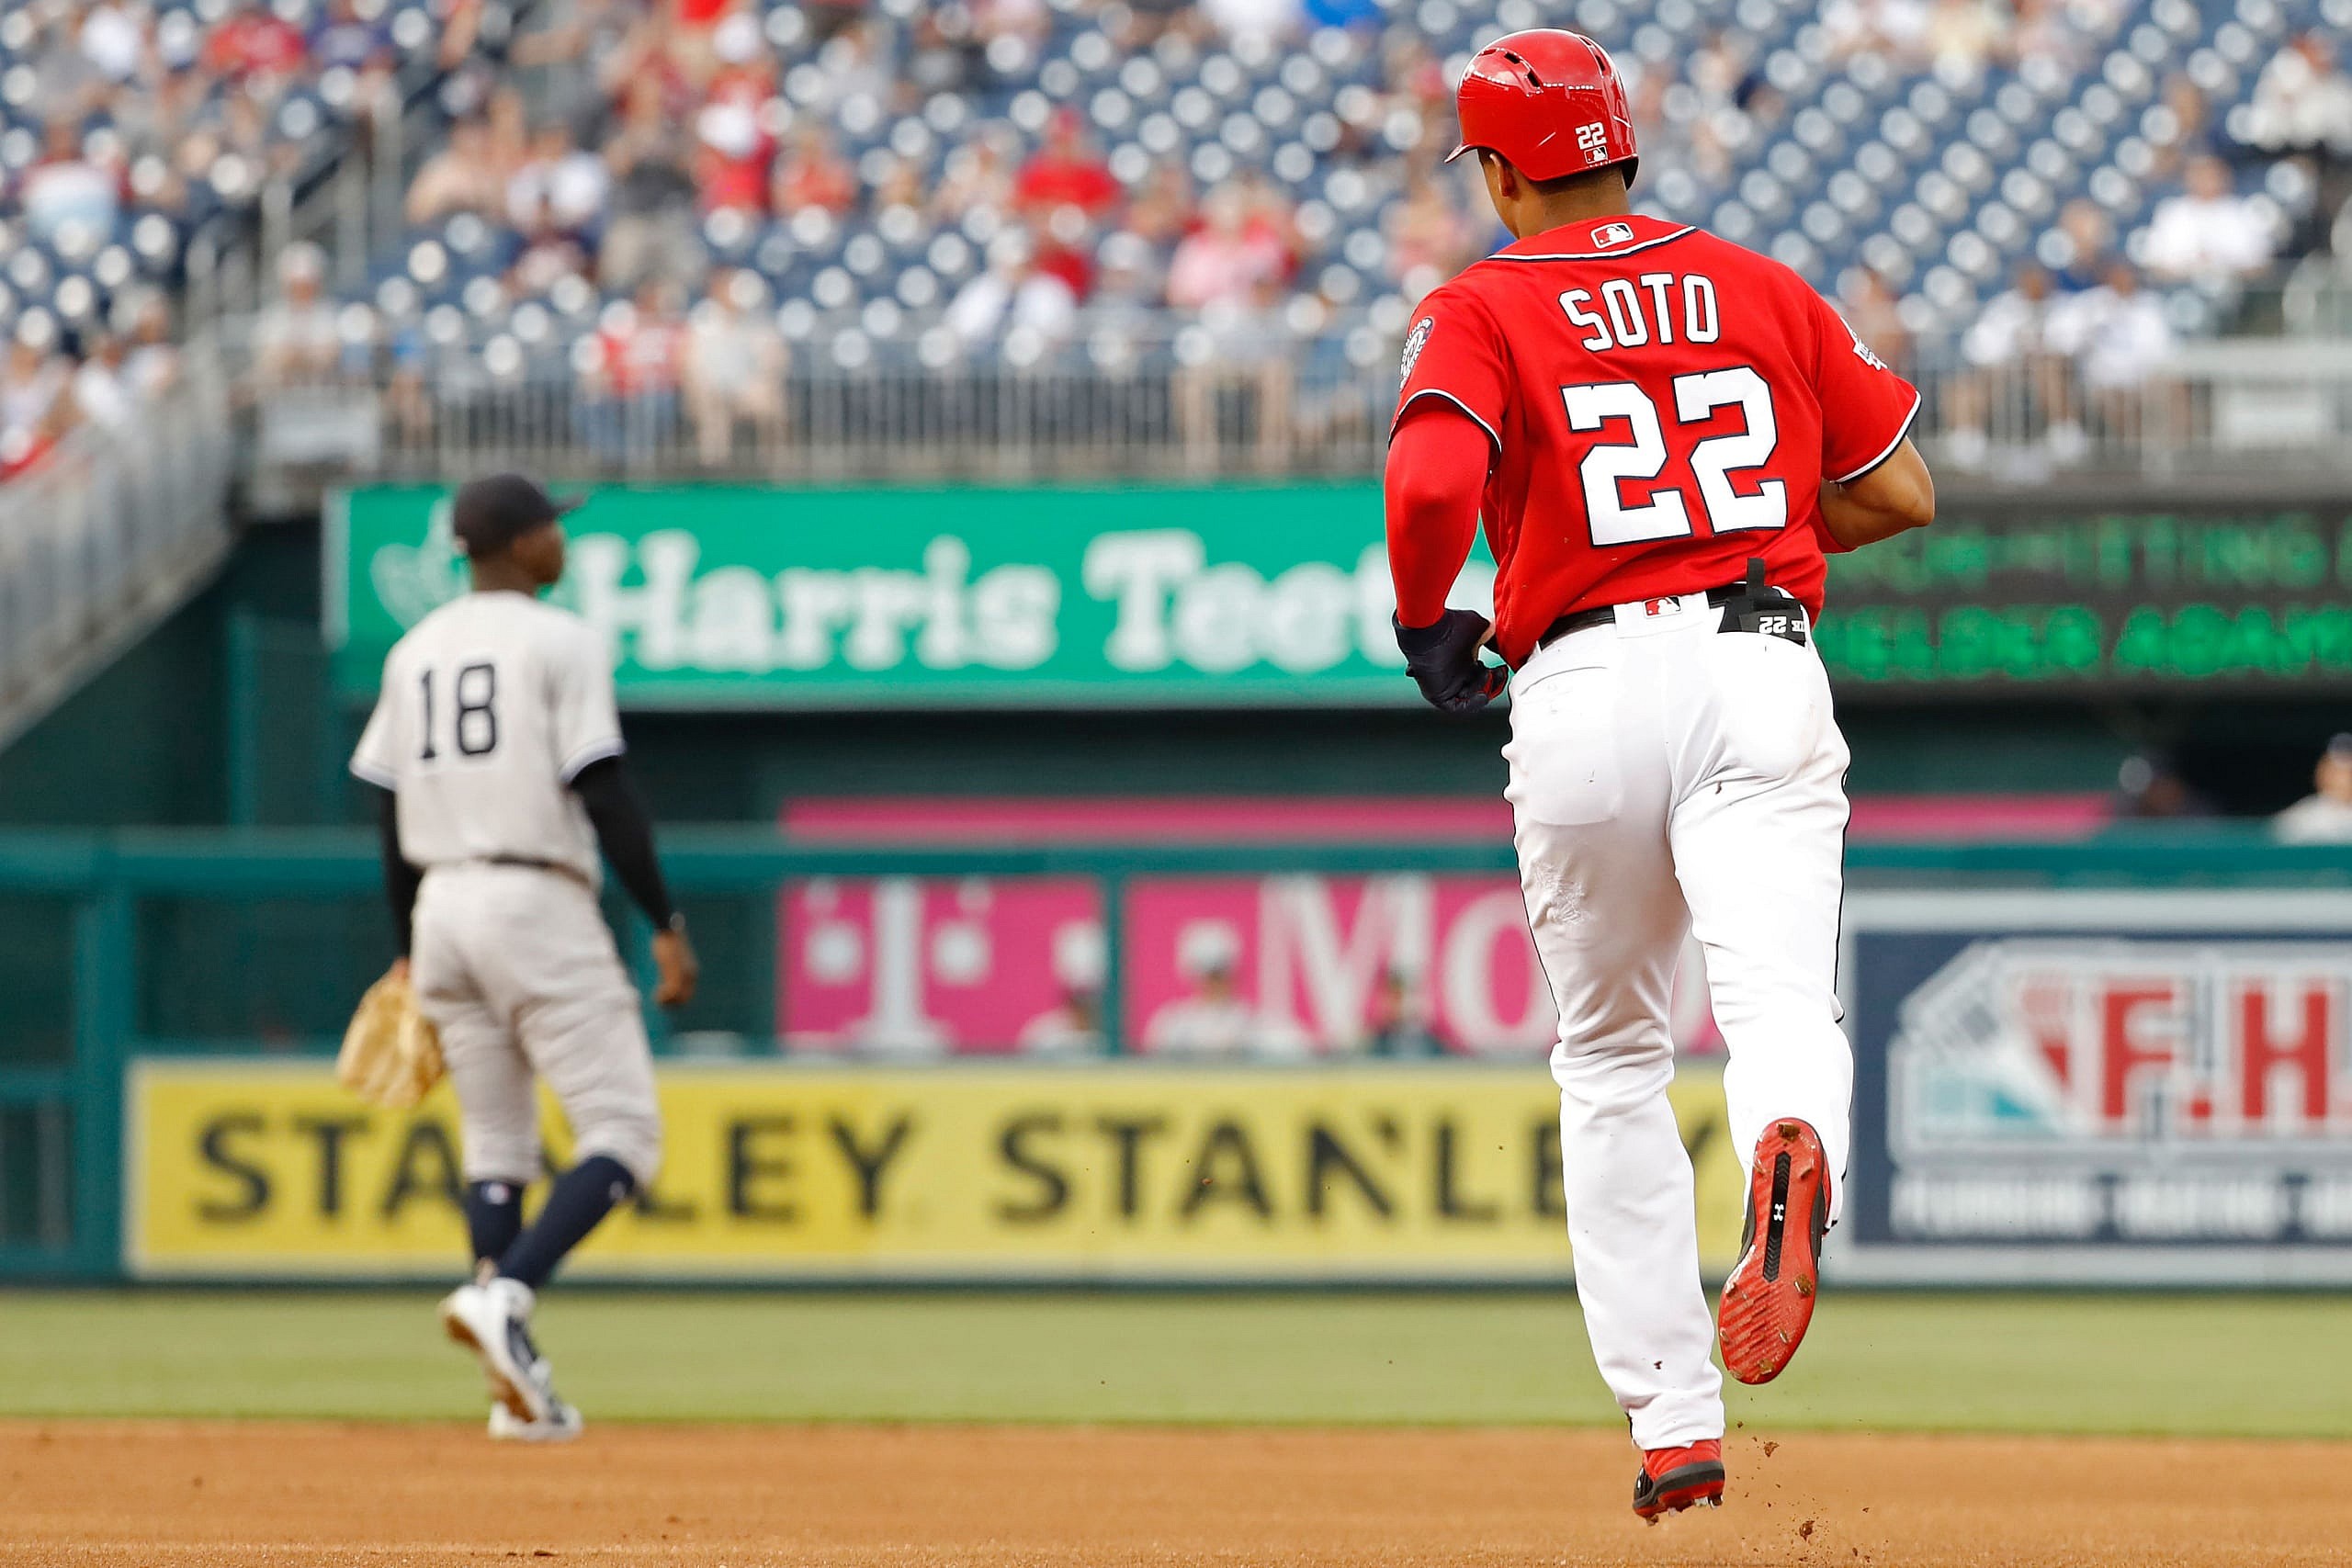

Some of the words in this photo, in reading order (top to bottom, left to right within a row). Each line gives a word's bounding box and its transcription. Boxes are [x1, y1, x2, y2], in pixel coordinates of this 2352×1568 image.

[1575, 121, 1608, 150] 22
[1558, 273, 1720, 353] SOTO
[1561, 366, 1787, 547] 22
[568, 529, 1062, 674] Harris
[413, 662, 498, 761] 18
[196, 1111, 914, 1224] STALEY
